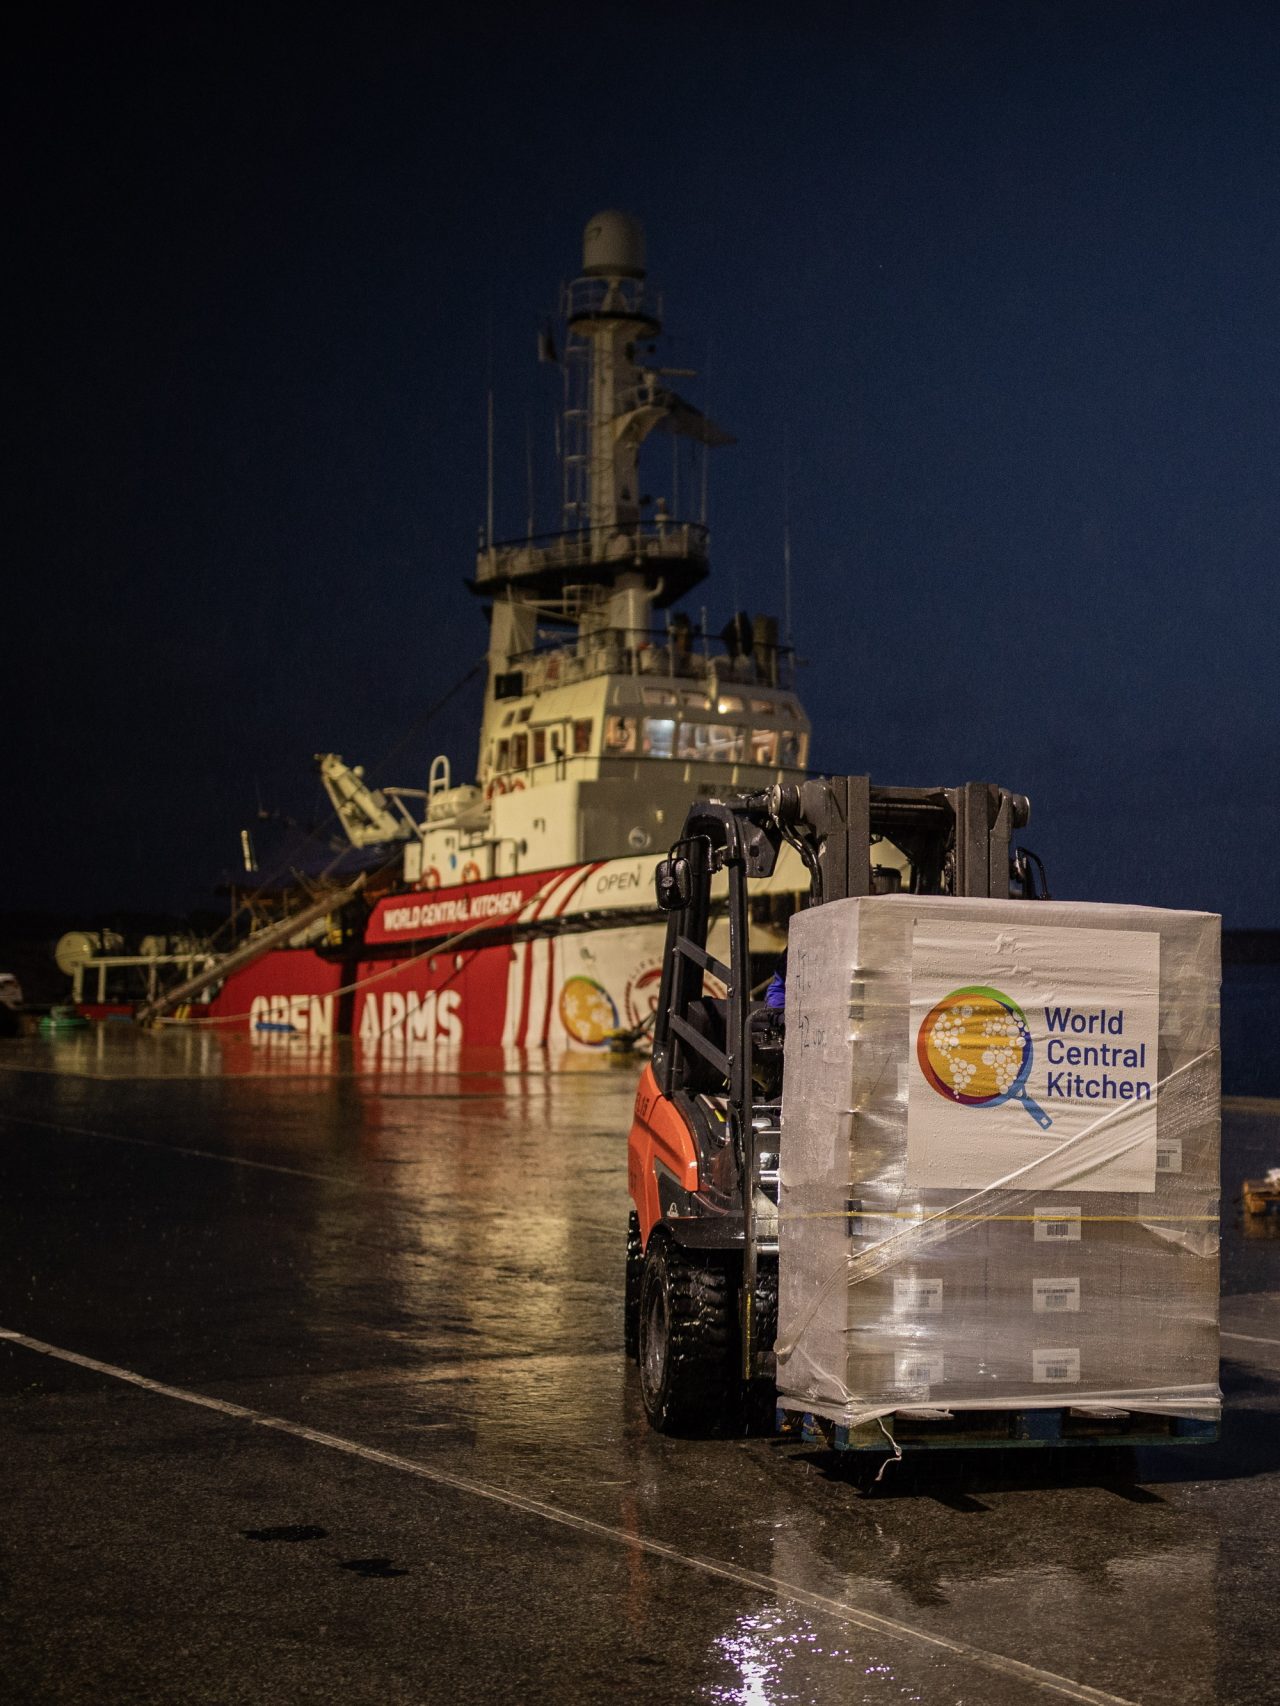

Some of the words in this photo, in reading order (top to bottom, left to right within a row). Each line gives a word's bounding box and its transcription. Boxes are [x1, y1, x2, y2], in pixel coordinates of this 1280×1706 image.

[596, 871, 641, 893] OPEN
[383, 906, 420, 931] WORLD
[420, 899, 470, 927] CENTRAL
[470, 890, 522, 918] KITCHEN
[252, 995, 334, 1037] OPEN
[360, 990, 463, 1041] ARMS
[1044, 1007, 1123, 1035] World
[1047, 1040, 1146, 1068] Central
[1047, 1072, 1151, 1100] Kitchen
